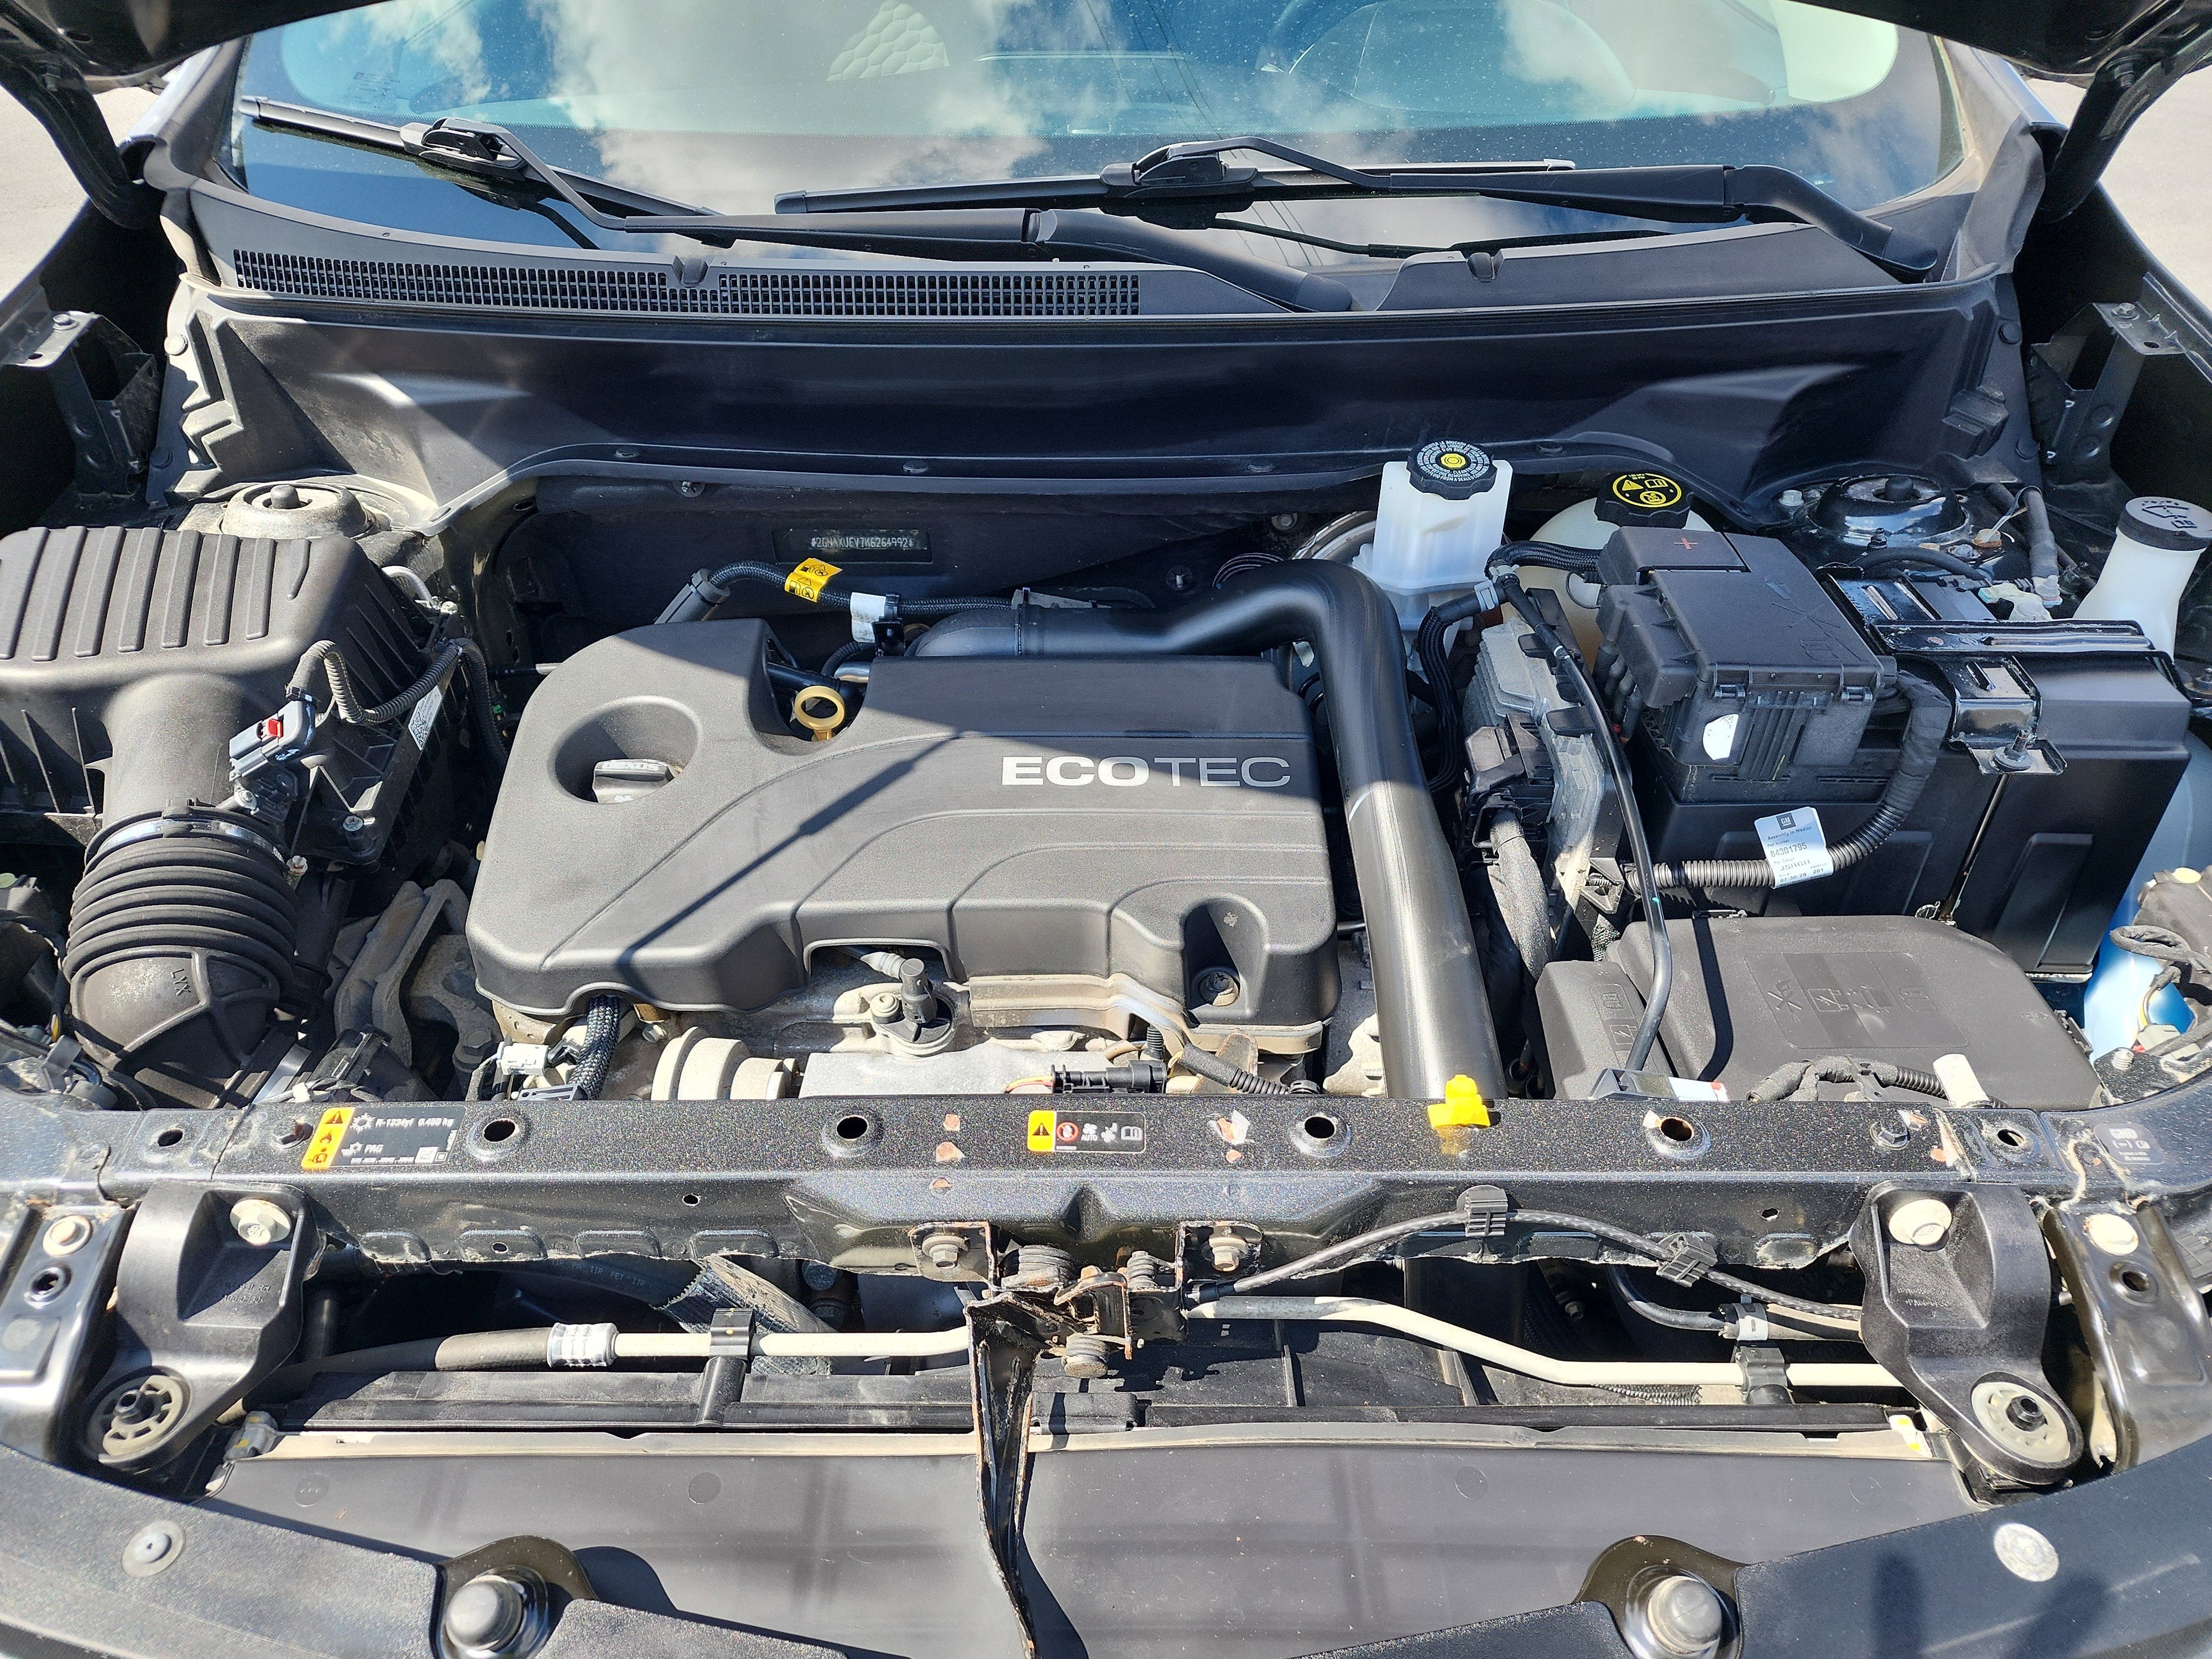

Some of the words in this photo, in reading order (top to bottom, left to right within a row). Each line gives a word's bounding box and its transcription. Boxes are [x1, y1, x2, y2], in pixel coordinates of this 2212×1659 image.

[1001, 756, 1291, 787] ECOTEC
[1781, 816, 1792, 826] GM
[1768, 832, 1790, 840] Assembly
[1770, 842, 1808, 858] 84301795
[2109, 1128, 2138, 1139] GND
[610, 1271, 625, 1281] PET
